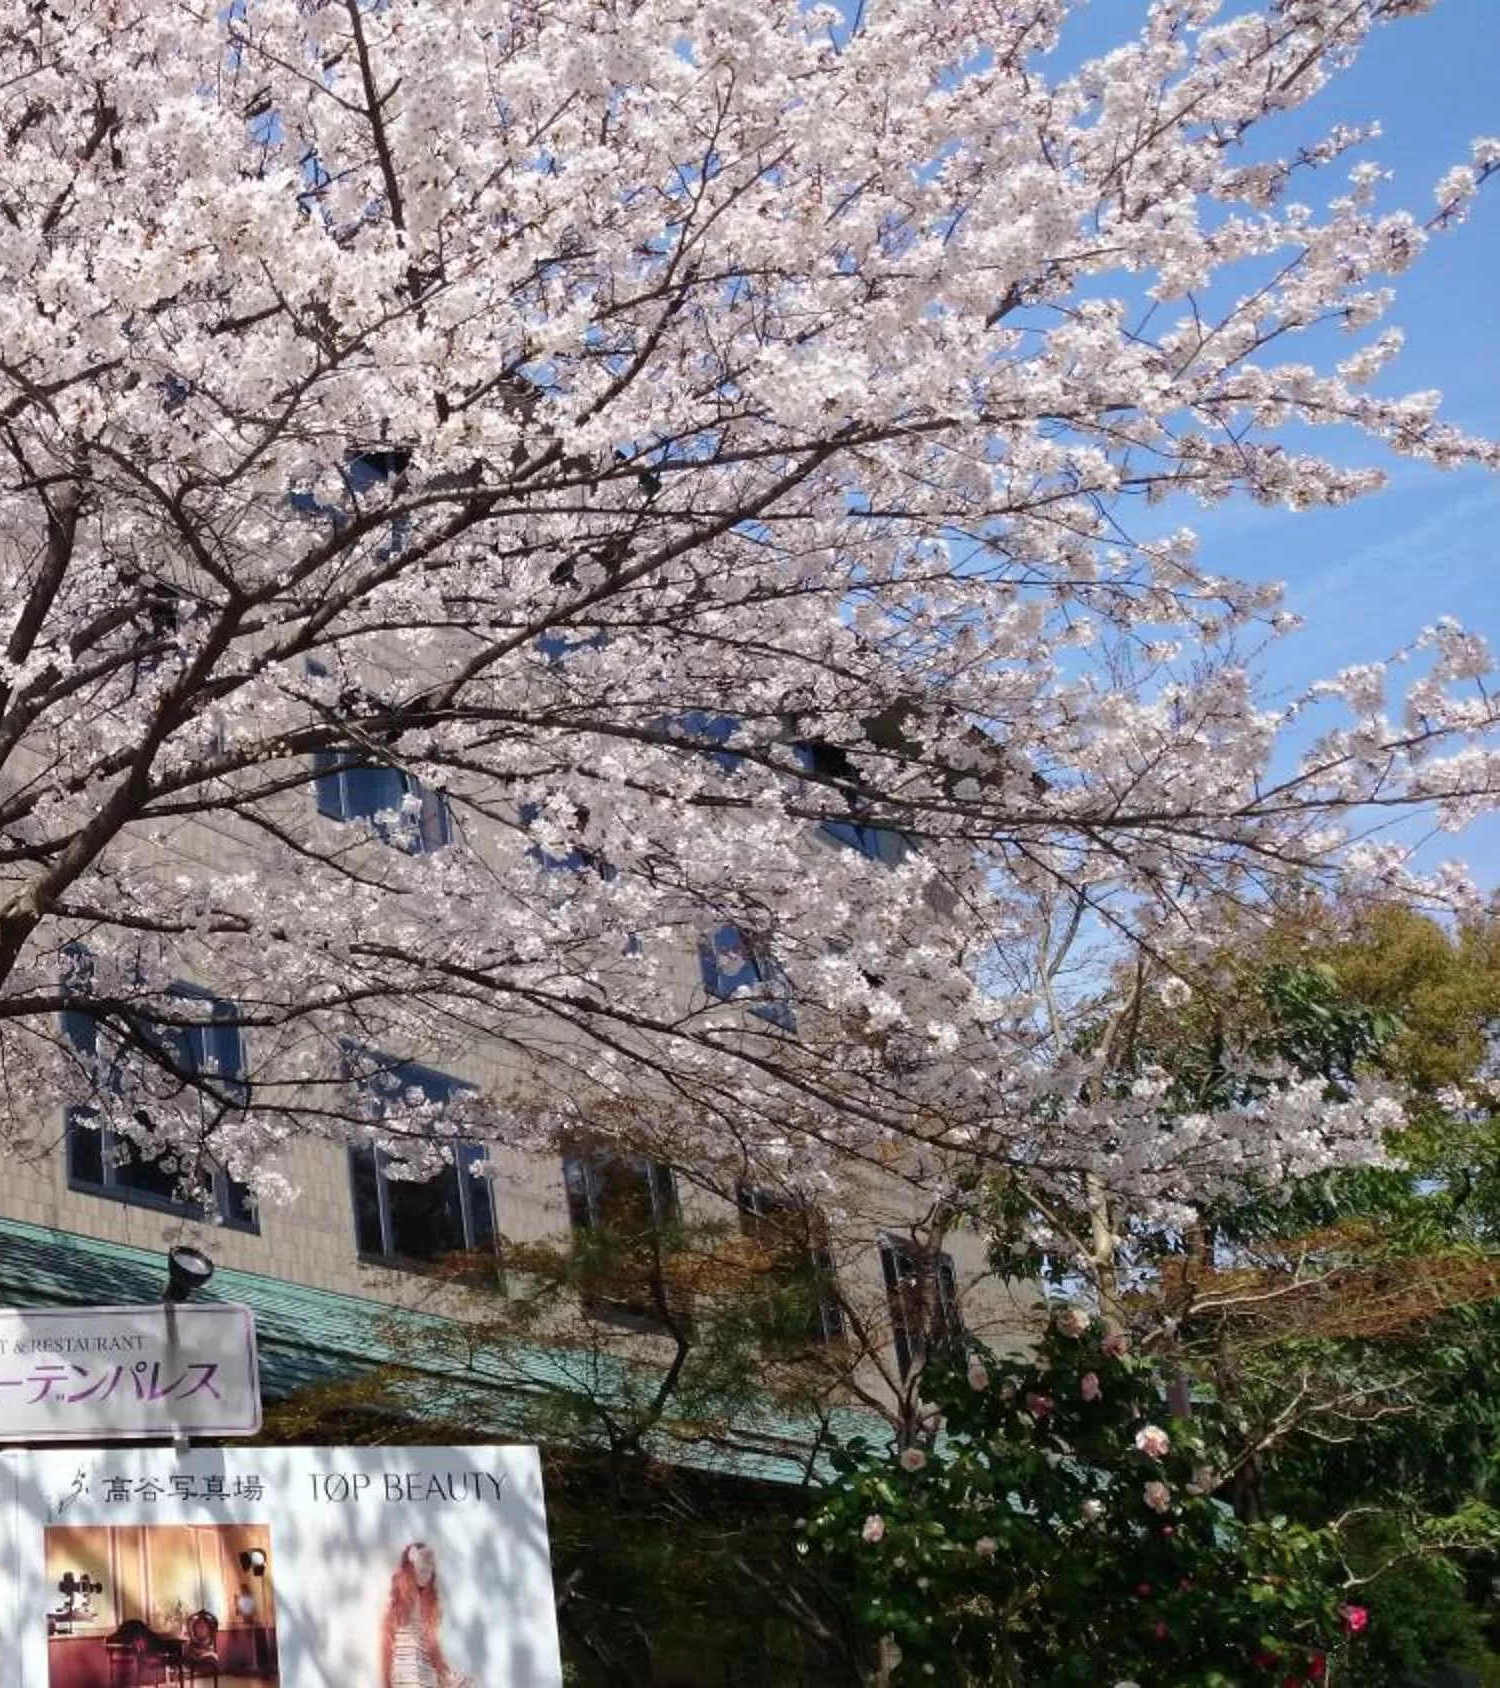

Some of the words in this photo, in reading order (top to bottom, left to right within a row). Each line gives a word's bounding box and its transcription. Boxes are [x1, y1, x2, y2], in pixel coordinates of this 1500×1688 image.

[13, 1339, 25, 1354] &
[29, 1335, 146, 1354] RESTAURANT
[383, 1471, 508, 1502] BEAUTY
